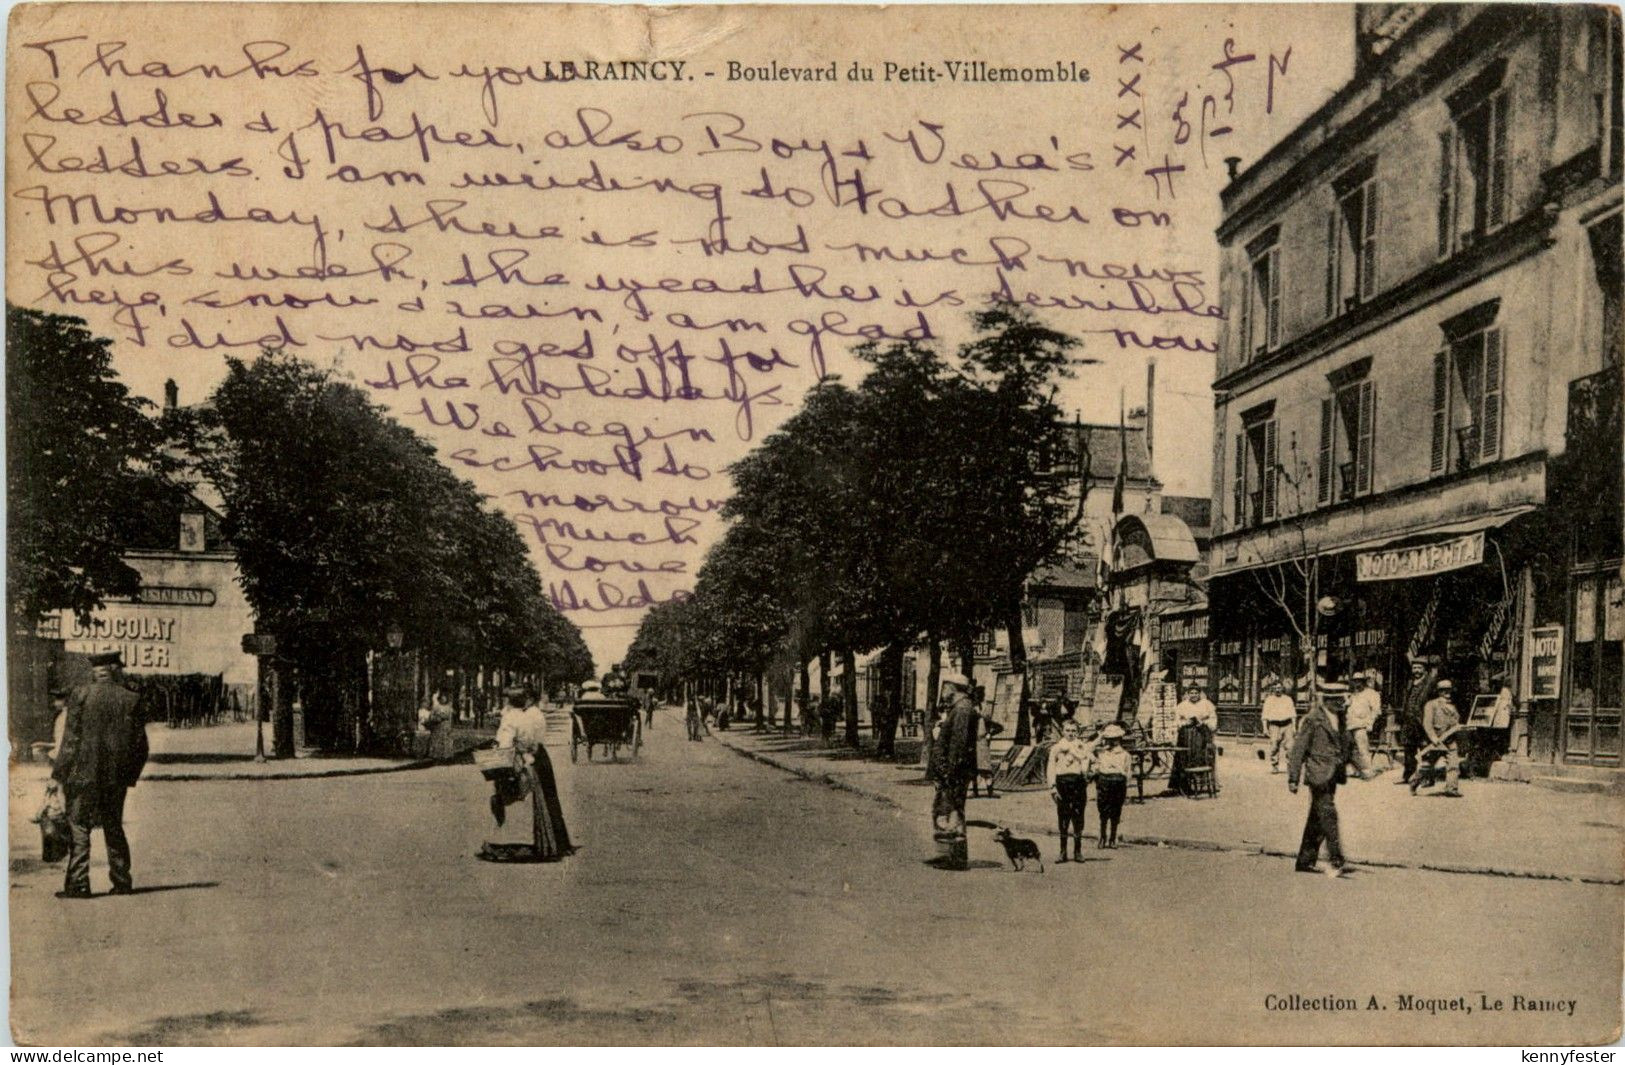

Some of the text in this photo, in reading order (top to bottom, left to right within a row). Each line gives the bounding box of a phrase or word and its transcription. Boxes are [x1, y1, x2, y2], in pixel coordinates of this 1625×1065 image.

[23, 36, 581, 127] Thanks for your
[26, 81, 223, 128] letter
[298, 107, 524, 164] paper,
[544, 108, 684, 154] also
[884, 121, 1093, 171] Vera's
[278, 131, 310, 179] I
[327, 165, 425, 186] am
[741, 167, 814, 207] to
[1113, 207, 1171, 227] on
[14, 185, 1205, 284] Monday, there is not much news
[25, 231, 192, 275] this
[443, 249, 570, 286] the
[585, 263, 884, 301] weather
[894, 280, 964, 307] is
[986, 266, 1230, 321] terrible
[113, 305, 149, 347] I
[167, 316, 307, 350] did
[316, 326, 472, 354] not
[182, 290, 380, 309] snow
[667, 311, 768, 335] am
[787, 311, 940, 381] glad
[1083, 328, 1221, 354] now
[365, 354, 470, 391] the
[404, 398, 515, 438] We
[450, 445, 643, 482] school
[514, 514, 701, 545] Much
[545, 543, 687, 573] love
